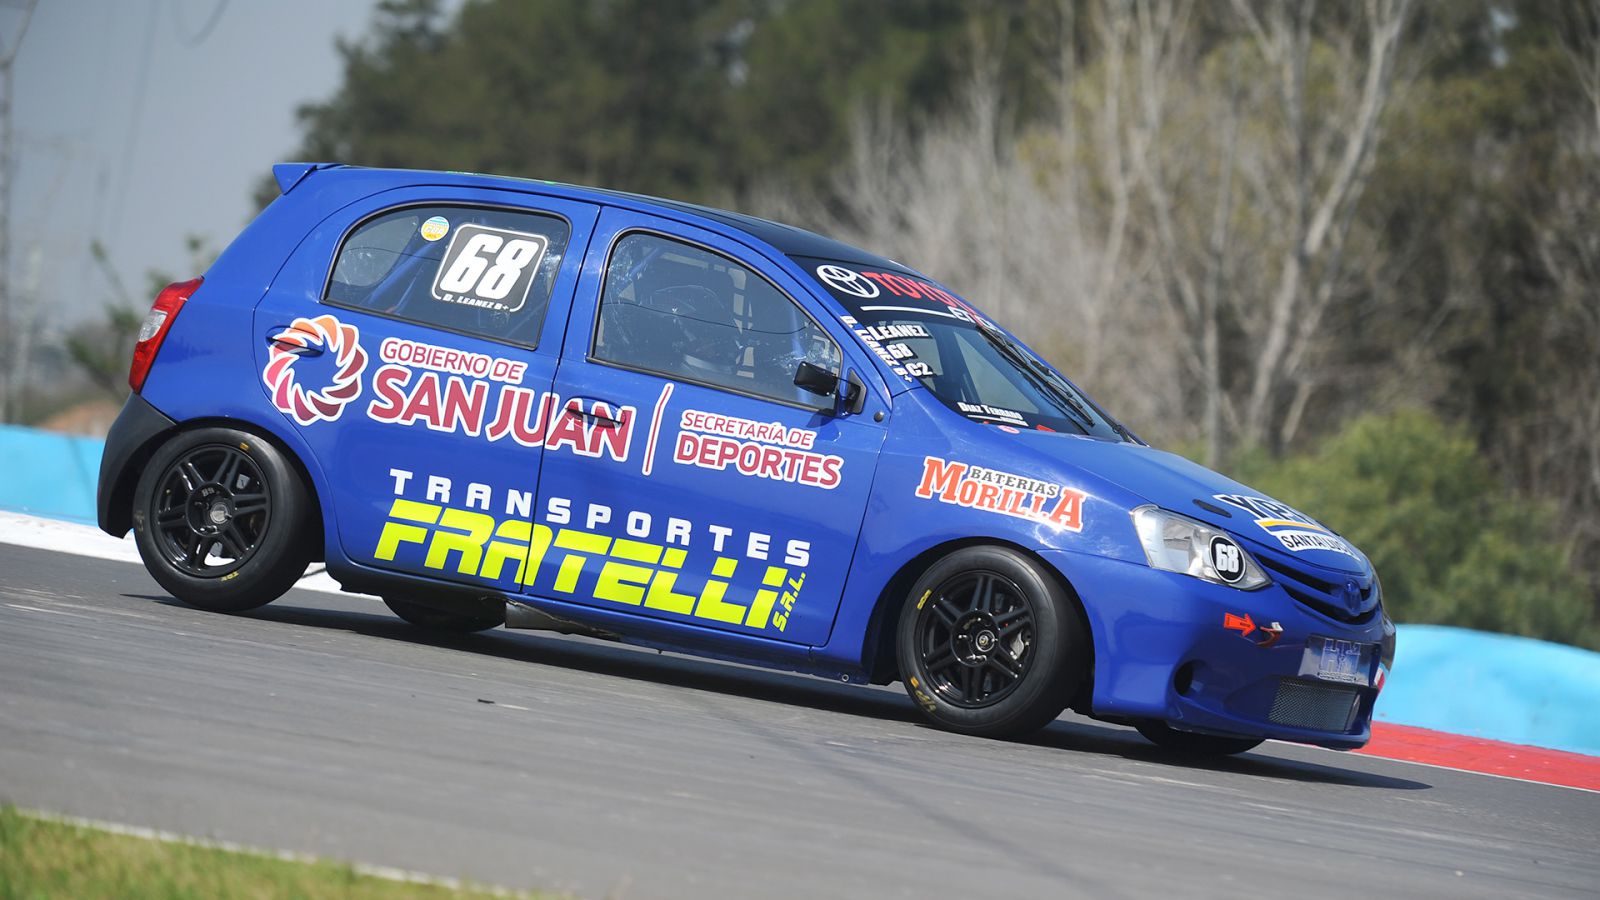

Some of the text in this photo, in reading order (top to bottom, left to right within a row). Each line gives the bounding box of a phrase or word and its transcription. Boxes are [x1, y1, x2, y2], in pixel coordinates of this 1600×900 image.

[440, 234, 539, 299] 68
[855, 329, 900, 366] LEANEZ
[866, 325, 929, 341] LEANEZ
[886, 343, 914, 359] 68
[384, 341, 524, 380] GOBIERNO DE
[905, 362, 933, 376] C2
[371, 368, 633, 458] SAN JUAN
[682, 412, 814, 446] SECRETARÍA DE
[676, 436, 841, 486] DEPORTES
[917, 458, 1085, 529] MORILLA
[970, 468, 1057, 496] BATERIAS
[389, 468, 811, 567] TRANSPORTES
[1215, 543, 1239, 573] 68
[1280, 534, 1323, 549] SANTA
[374, 498, 788, 629] FRATELLI
[771, 572, 807, 632] S.R.L.
